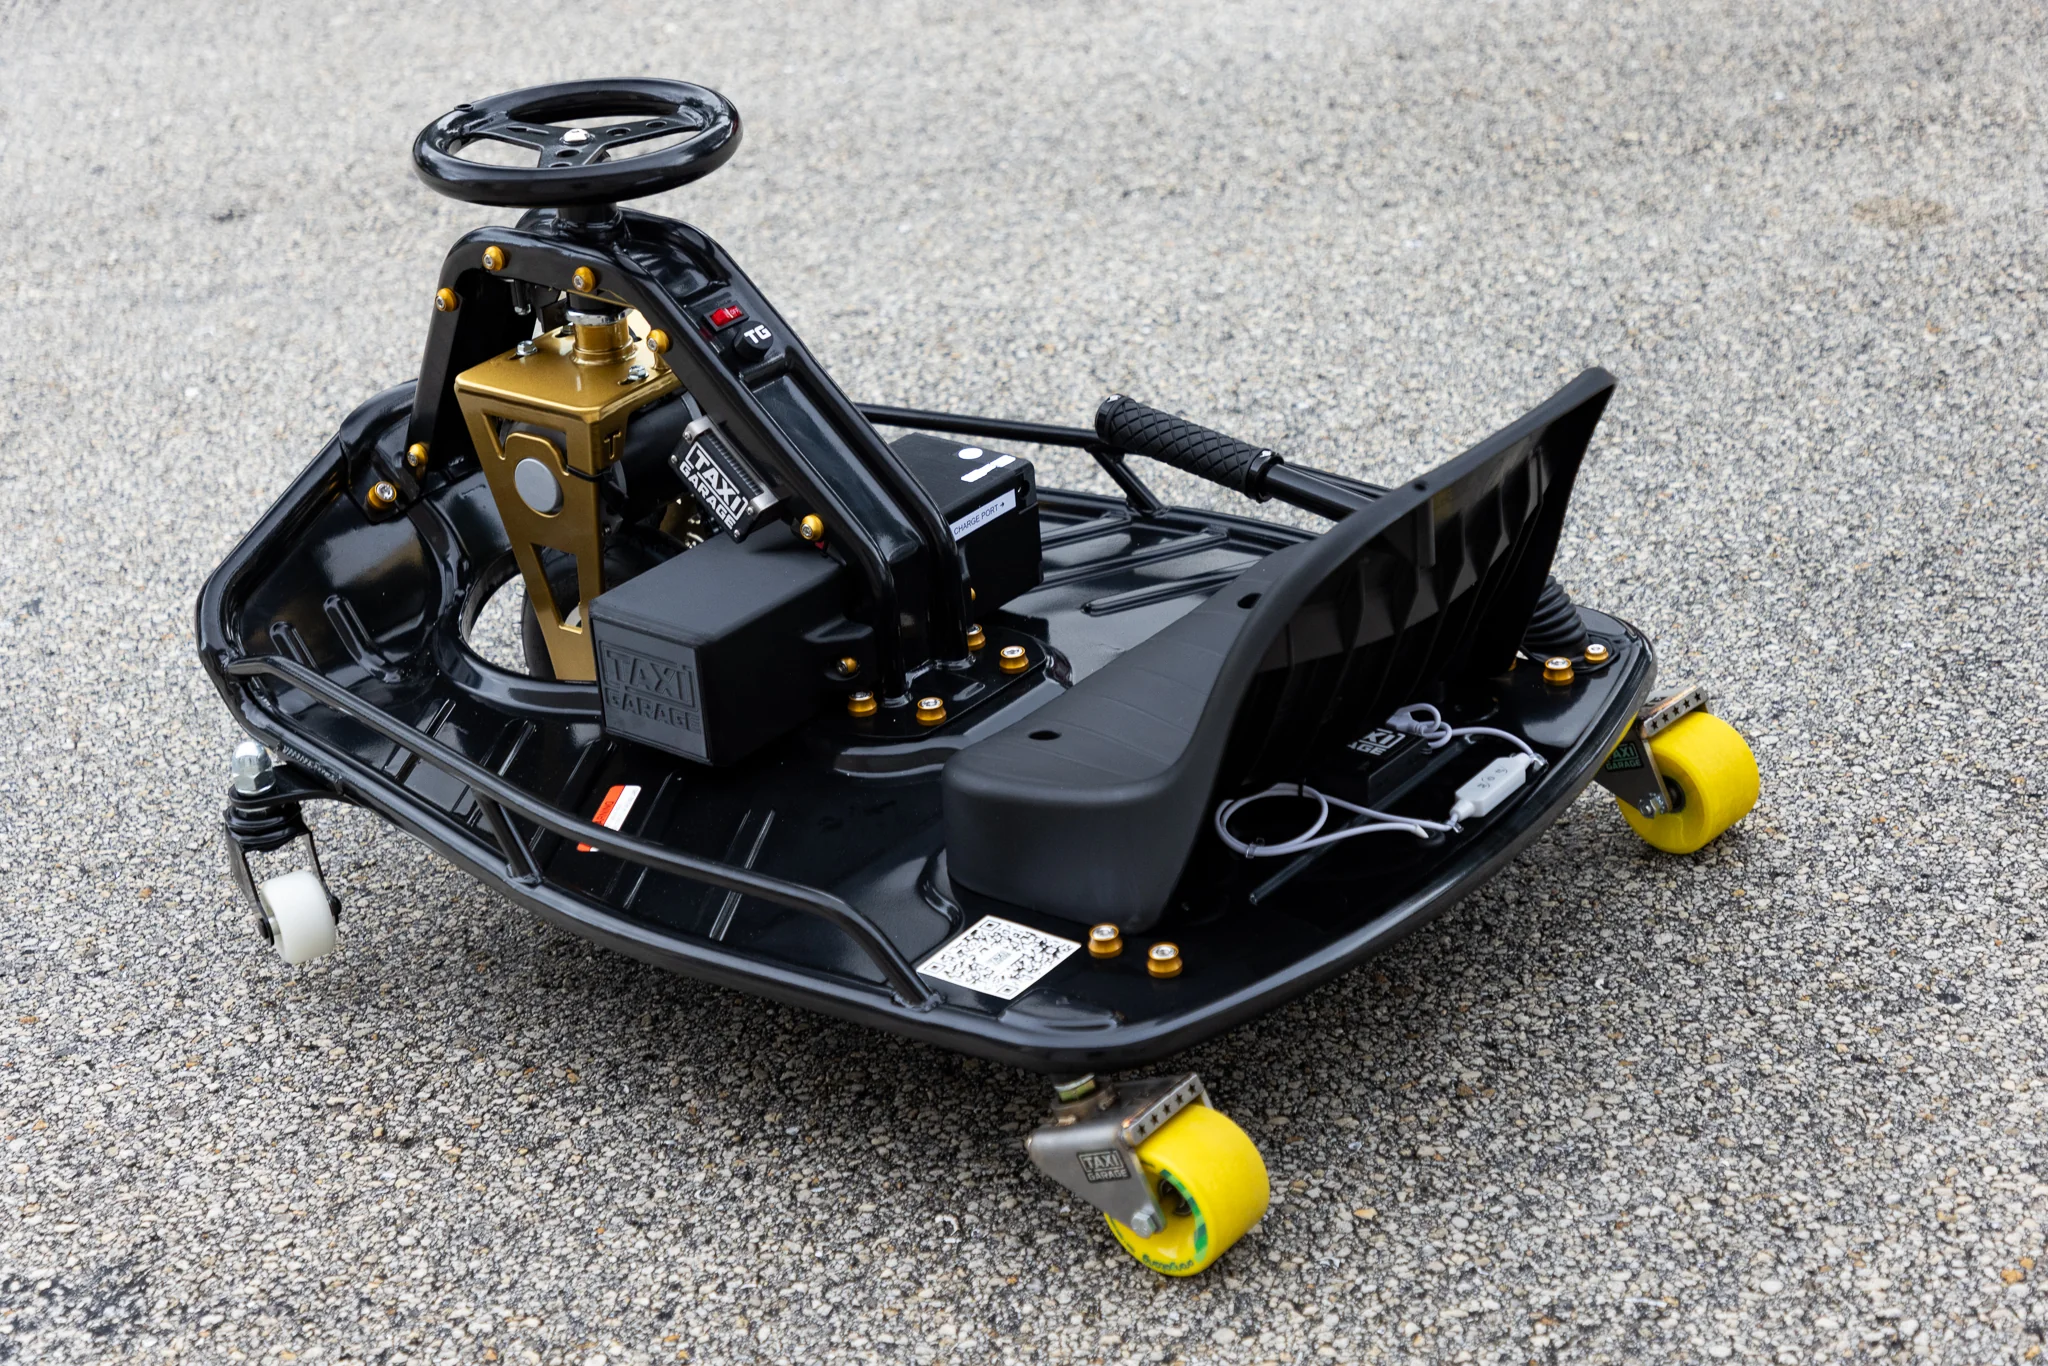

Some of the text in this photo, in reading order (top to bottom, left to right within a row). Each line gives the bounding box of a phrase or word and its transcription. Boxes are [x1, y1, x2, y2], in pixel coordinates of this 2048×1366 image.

[744, 325, 771, 344] TG
[680, 461, 736, 530] GARAGE
[695, 449, 741, 512] TAXI
[953, 503, 999, 535] CHARGE PORT
[606, 650, 688, 701] TAXI
[604, 687, 701, 734] GARAGE
[1605, 760, 1642, 770] GARAGE
[1083, 1154, 1119, 1169] TAXI
[1087, 1169, 1128, 1180] GARAGE
